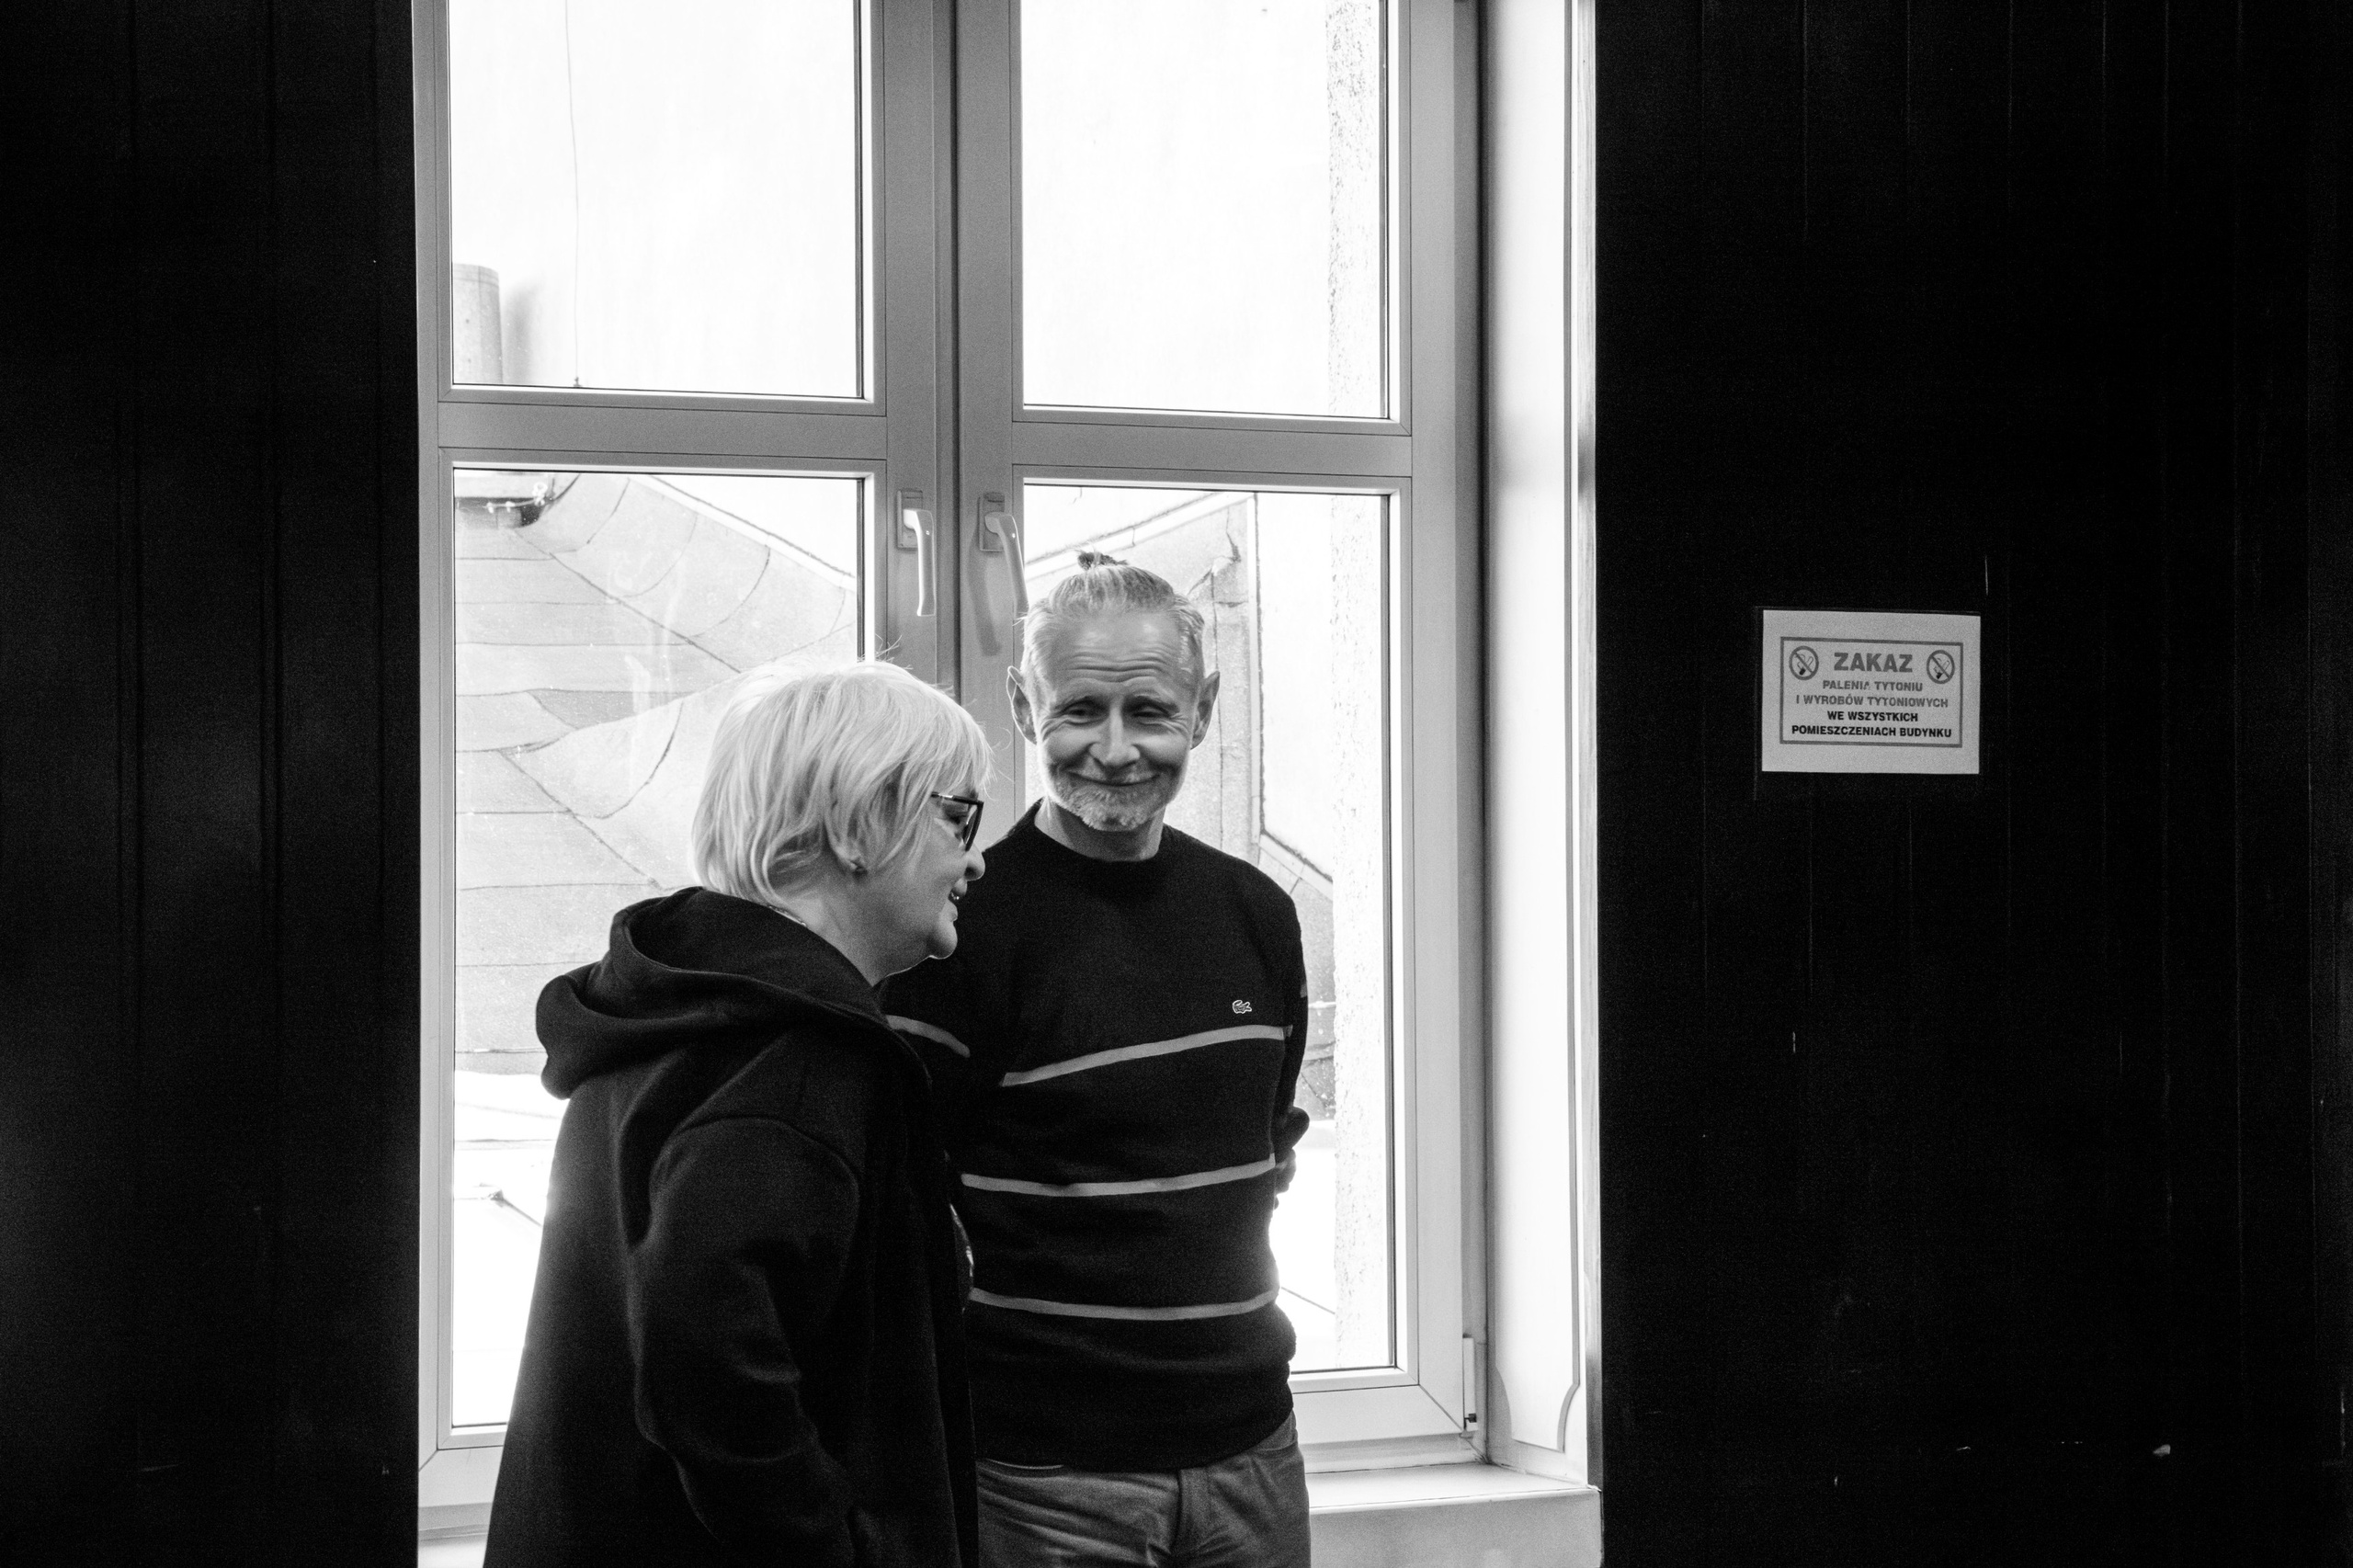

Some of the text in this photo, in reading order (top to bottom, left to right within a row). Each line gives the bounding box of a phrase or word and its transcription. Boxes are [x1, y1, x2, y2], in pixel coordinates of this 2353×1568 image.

[1834, 652, 1914, 673] ZAKAZ
[1874, 681, 1923, 692] TYTONIU
[1796, 693, 1949, 708] I WYROBÓW TYTONIOWYCH
[1827, 710, 1918, 722] WE WSZYSTKICH
[1791, 725, 1952, 738] POMIESZCZENIACH BUDYNKU
